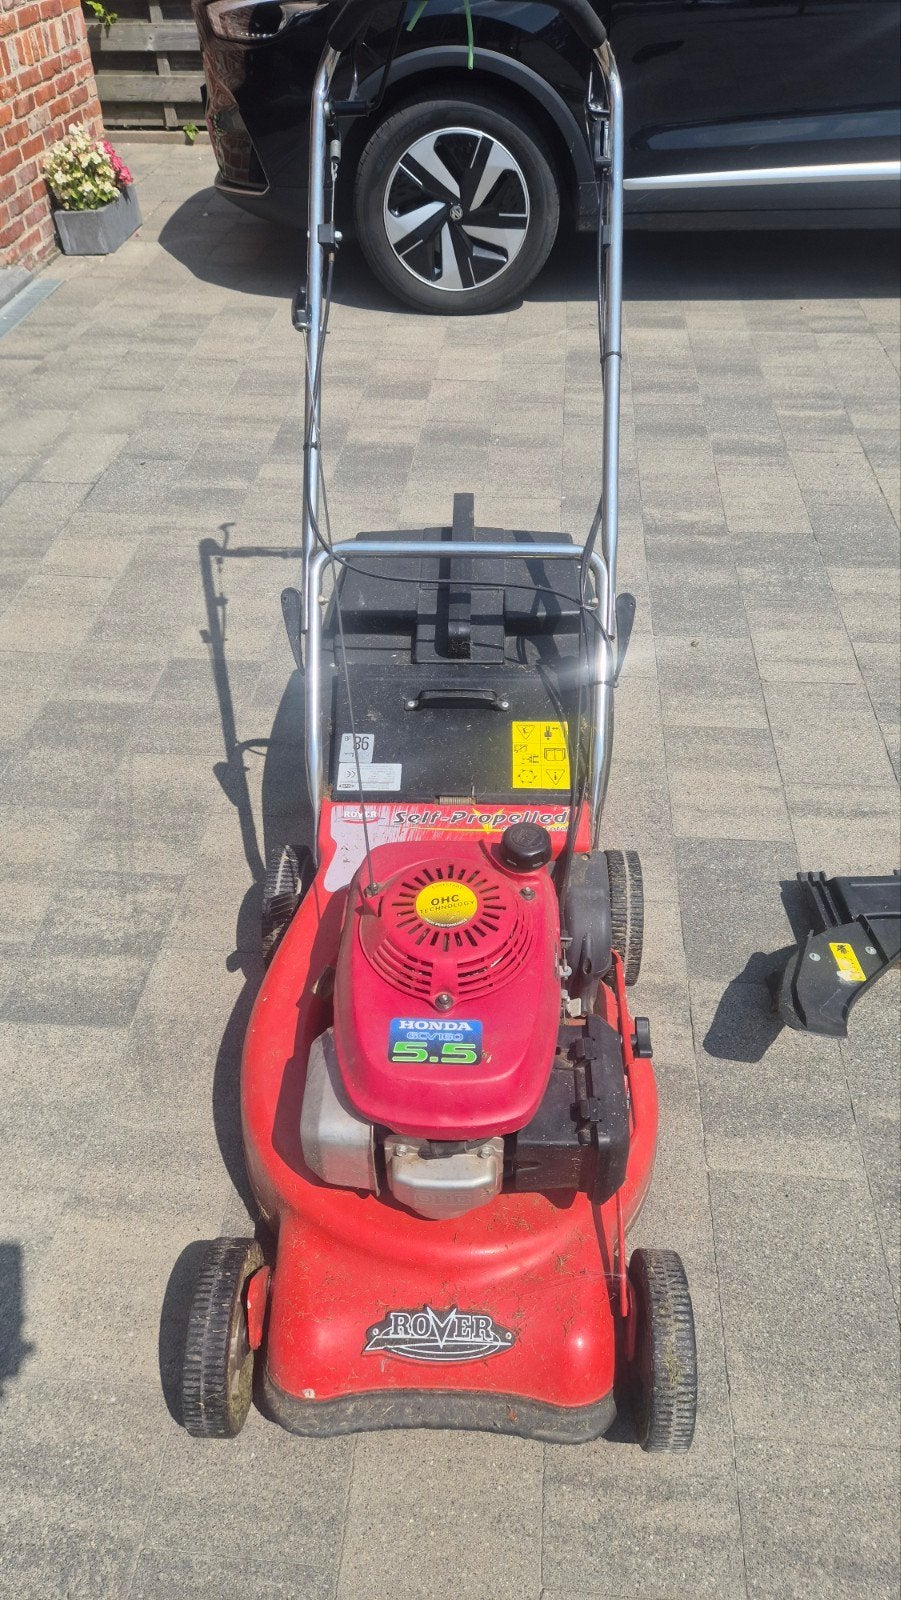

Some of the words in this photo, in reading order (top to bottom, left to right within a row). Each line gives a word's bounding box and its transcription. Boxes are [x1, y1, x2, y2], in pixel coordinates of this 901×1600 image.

[393, 810, 568, 827] Self-Propelled
[420, 900, 475, 914] TECHNOLOGY
[430, 894, 460, 906] OHC
[399, 1020, 473, 1031] HONDA
[392, 1041, 477, 1064] 5.5
[390, 1306, 494, 1349] ROVER
